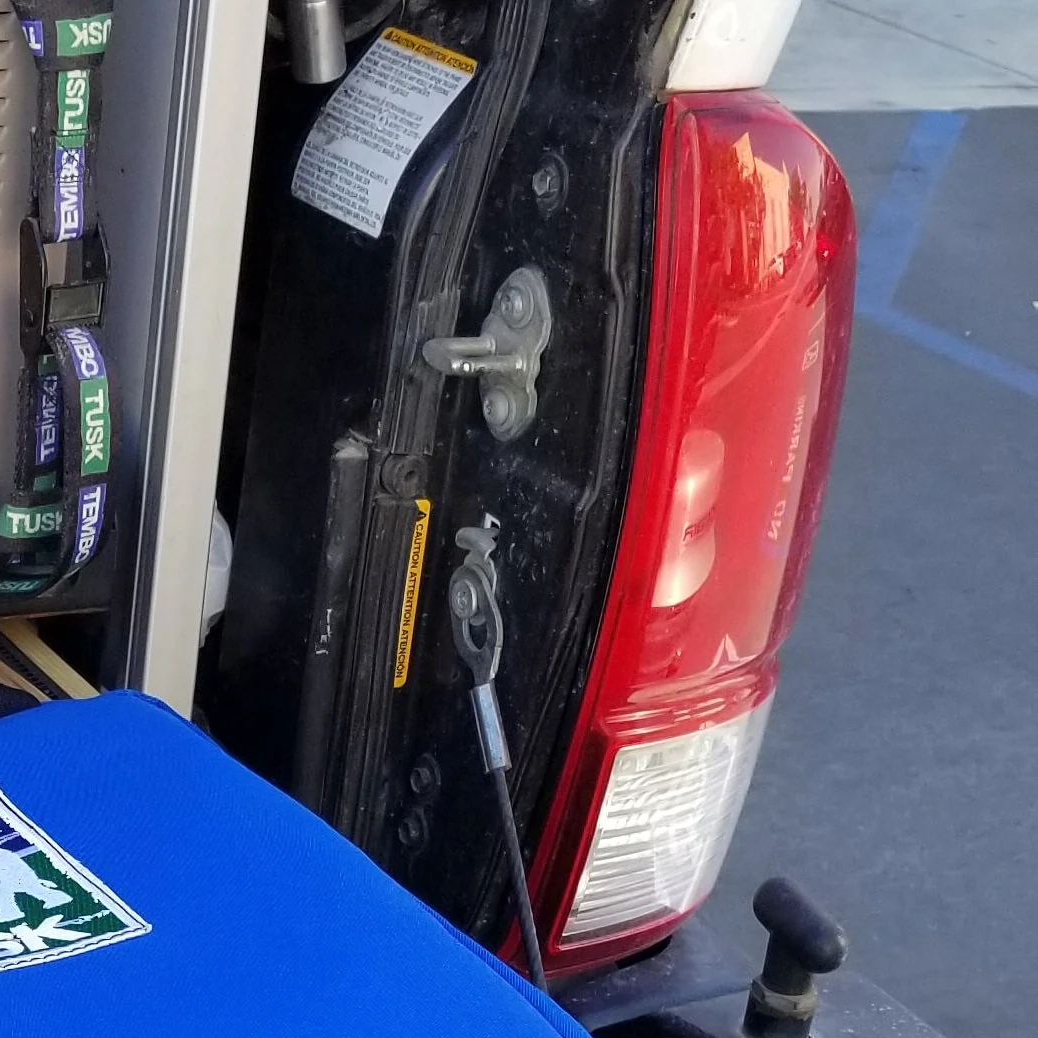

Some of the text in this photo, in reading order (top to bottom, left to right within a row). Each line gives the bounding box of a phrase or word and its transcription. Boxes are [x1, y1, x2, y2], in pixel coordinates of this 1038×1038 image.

[69, 18, 112, 48] USK
[66, 327, 100, 377] MBO
[84, 389, 104, 464] TUSK
[75, 487, 101, 564] TEMBO
[411, 523, 424, 568] CAUTION
[403, 571, 417, 626] ATTENTION
